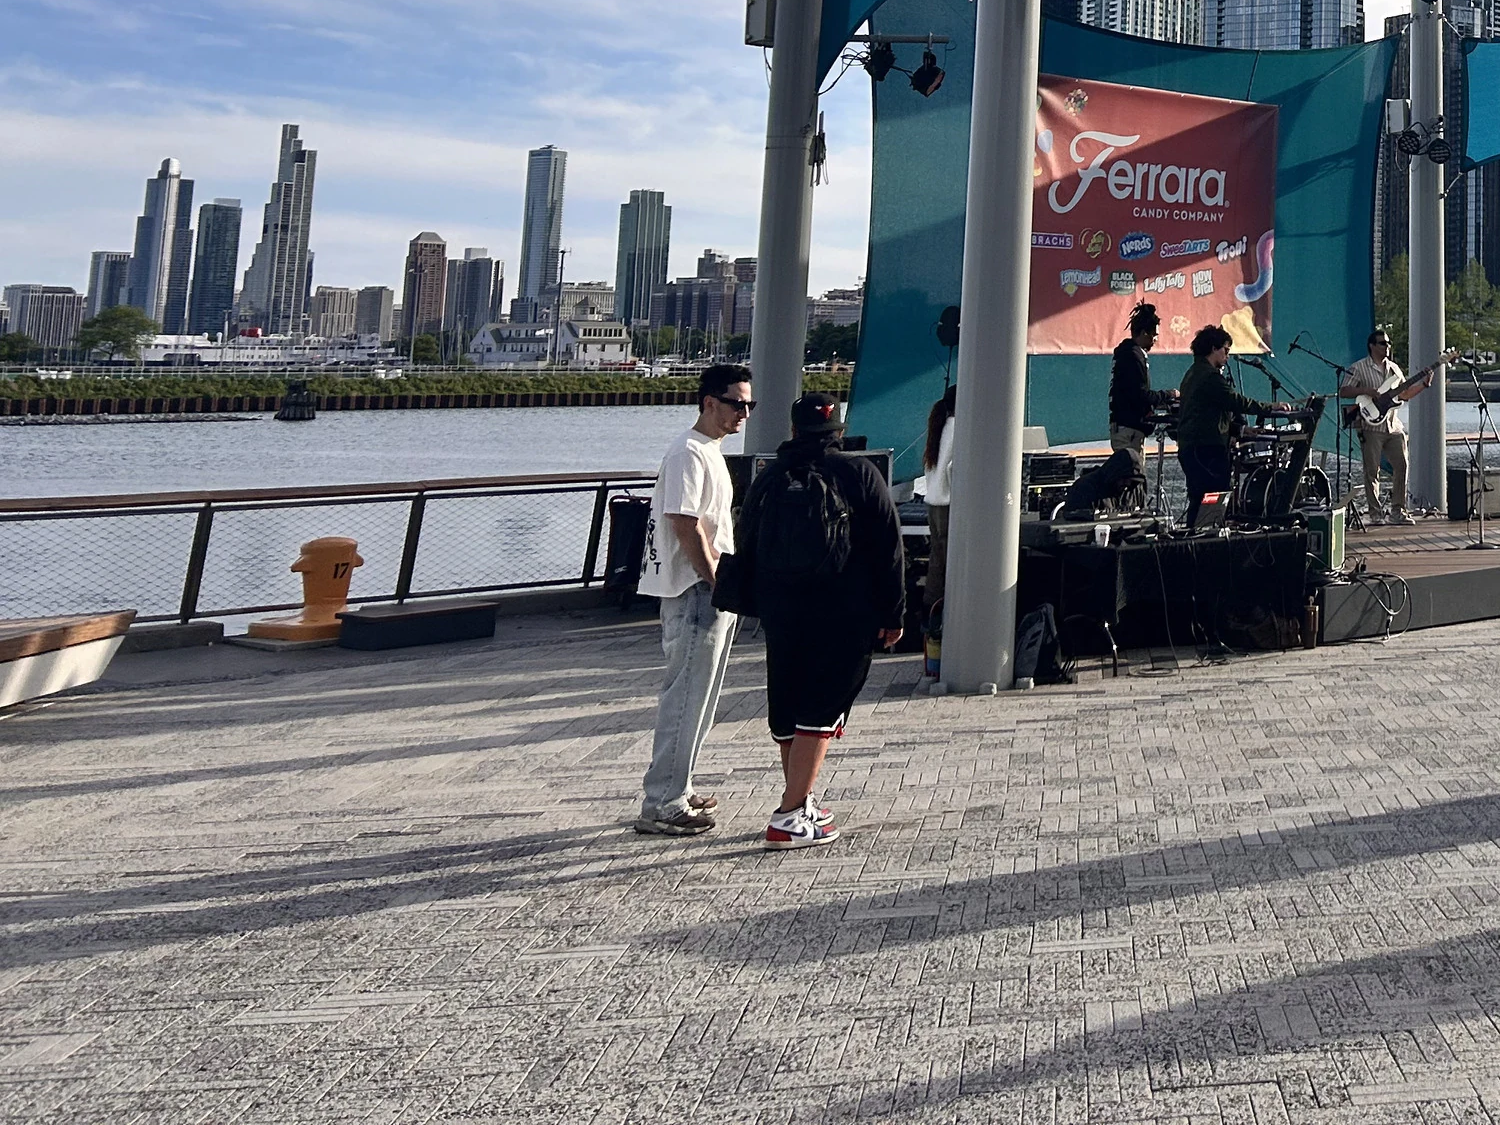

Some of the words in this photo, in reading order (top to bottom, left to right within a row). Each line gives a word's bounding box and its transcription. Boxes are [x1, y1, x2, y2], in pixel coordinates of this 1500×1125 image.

[1048, 131, 1228, 214] Ferrara
[1132, 206, 1170, 220] CANDY
[1173, 210, 1224, 222] COMPANY
[1216, 235, 1247, 262] Trolli
[1112, 272, 1134, 281] BLACK
[1143, 277, 1166, 293] Laffy
[1165, 272, 1186, 289] Taffy
[1192, 269, 1212, 283] NOW
[1110, 280, 1135, 290] FOREST
[333, 562, 350, 579] 17
